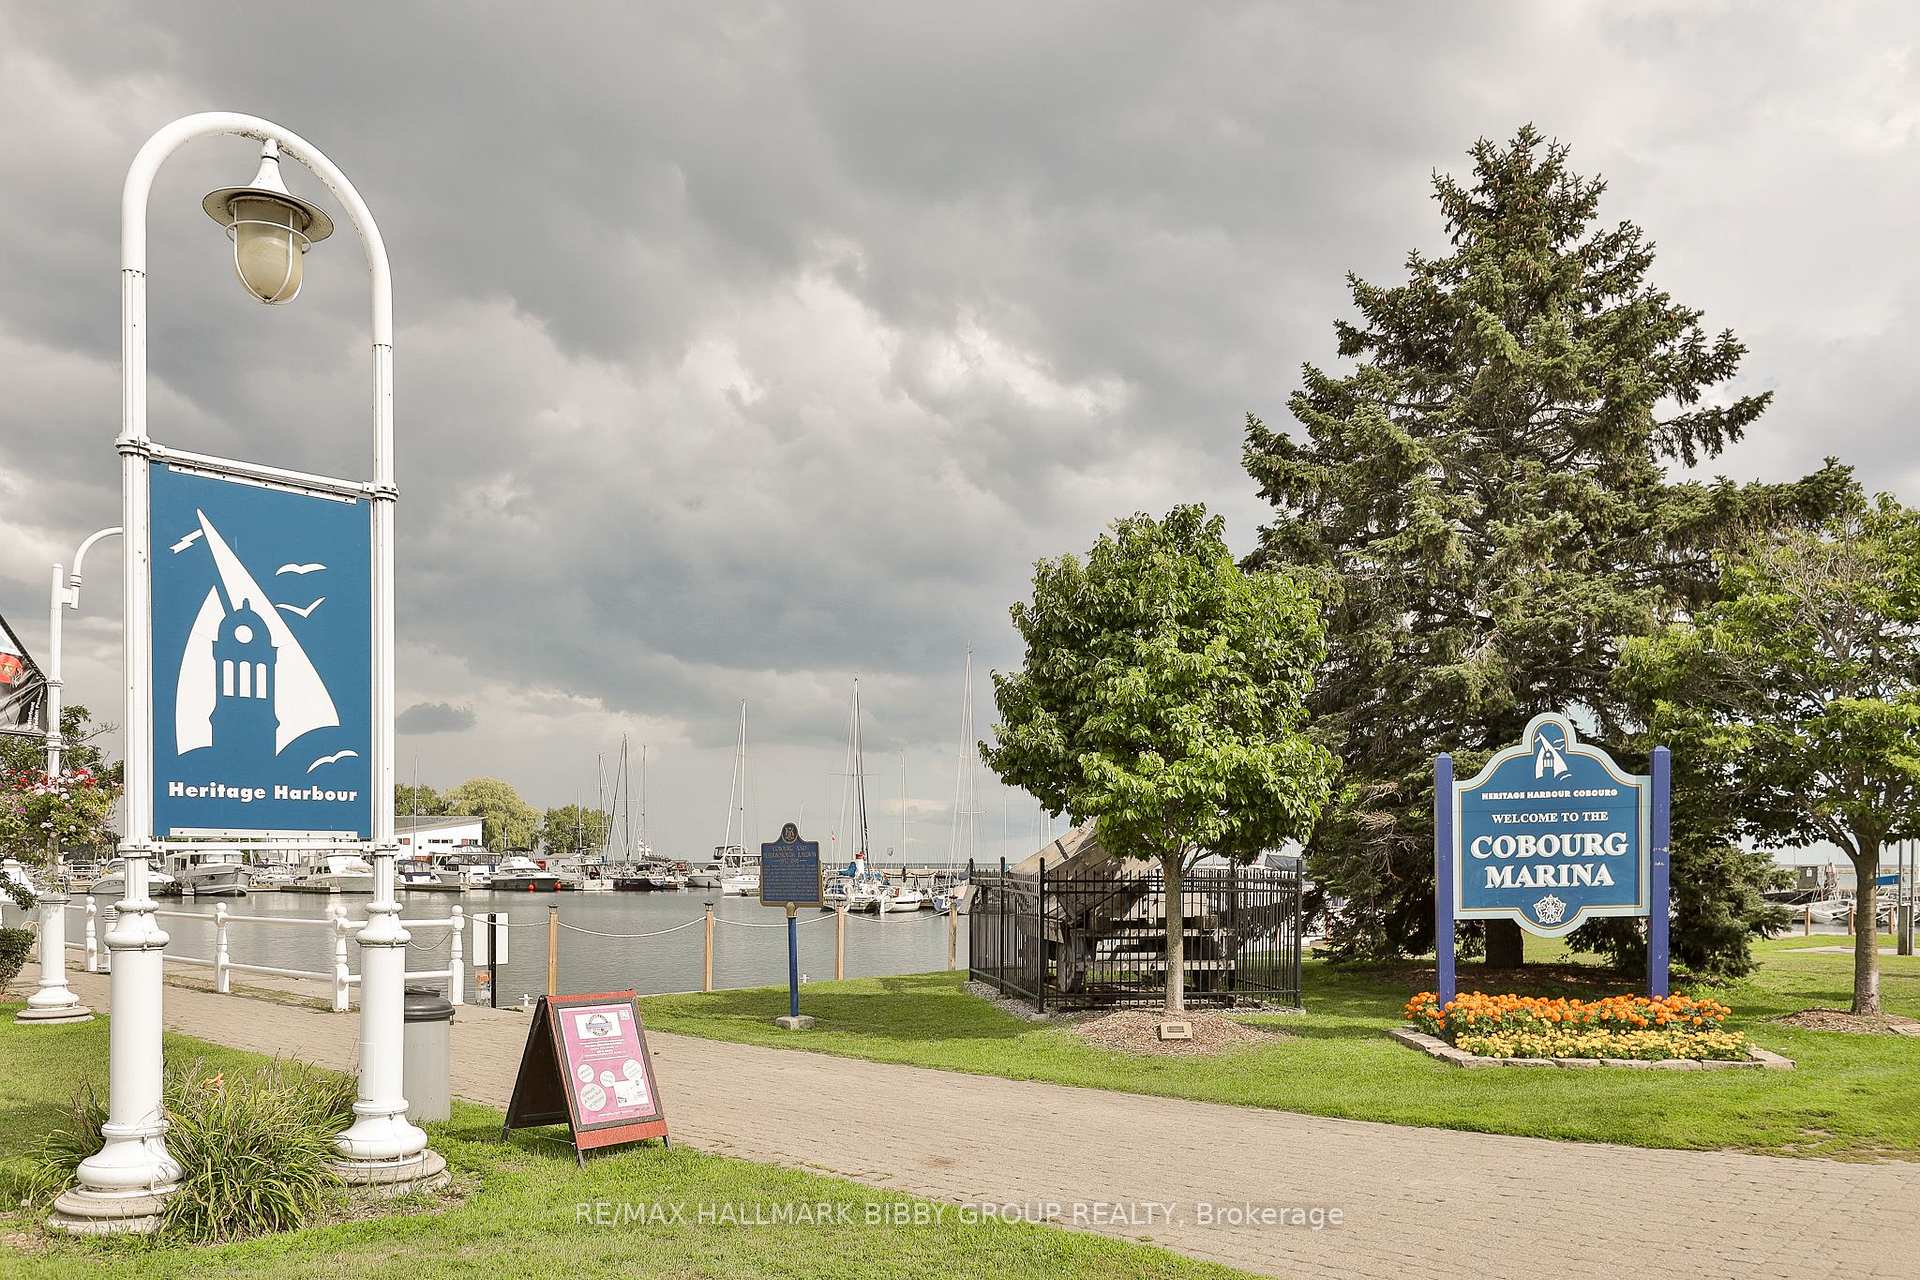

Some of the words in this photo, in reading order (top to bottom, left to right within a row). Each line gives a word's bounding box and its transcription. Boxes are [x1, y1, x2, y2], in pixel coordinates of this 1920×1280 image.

[168, 781, 266, 803] Heritage
[274, 785, 359, 802] Harbour
[1481, 792, 1525, 800] HERITAGE
[1527, 790, 1571, 799] HARBOUR
[1573, 788, 1618, 798] COBOURG
[1491, 812, 1558, 824] WELCOME
[1561, 812, 1579, 822] TO
[1582, 811, 1609, 822] THE
[1470, 831, 1629, 859] COBOURG
[1484, 863, 1616, 888] MARINA
